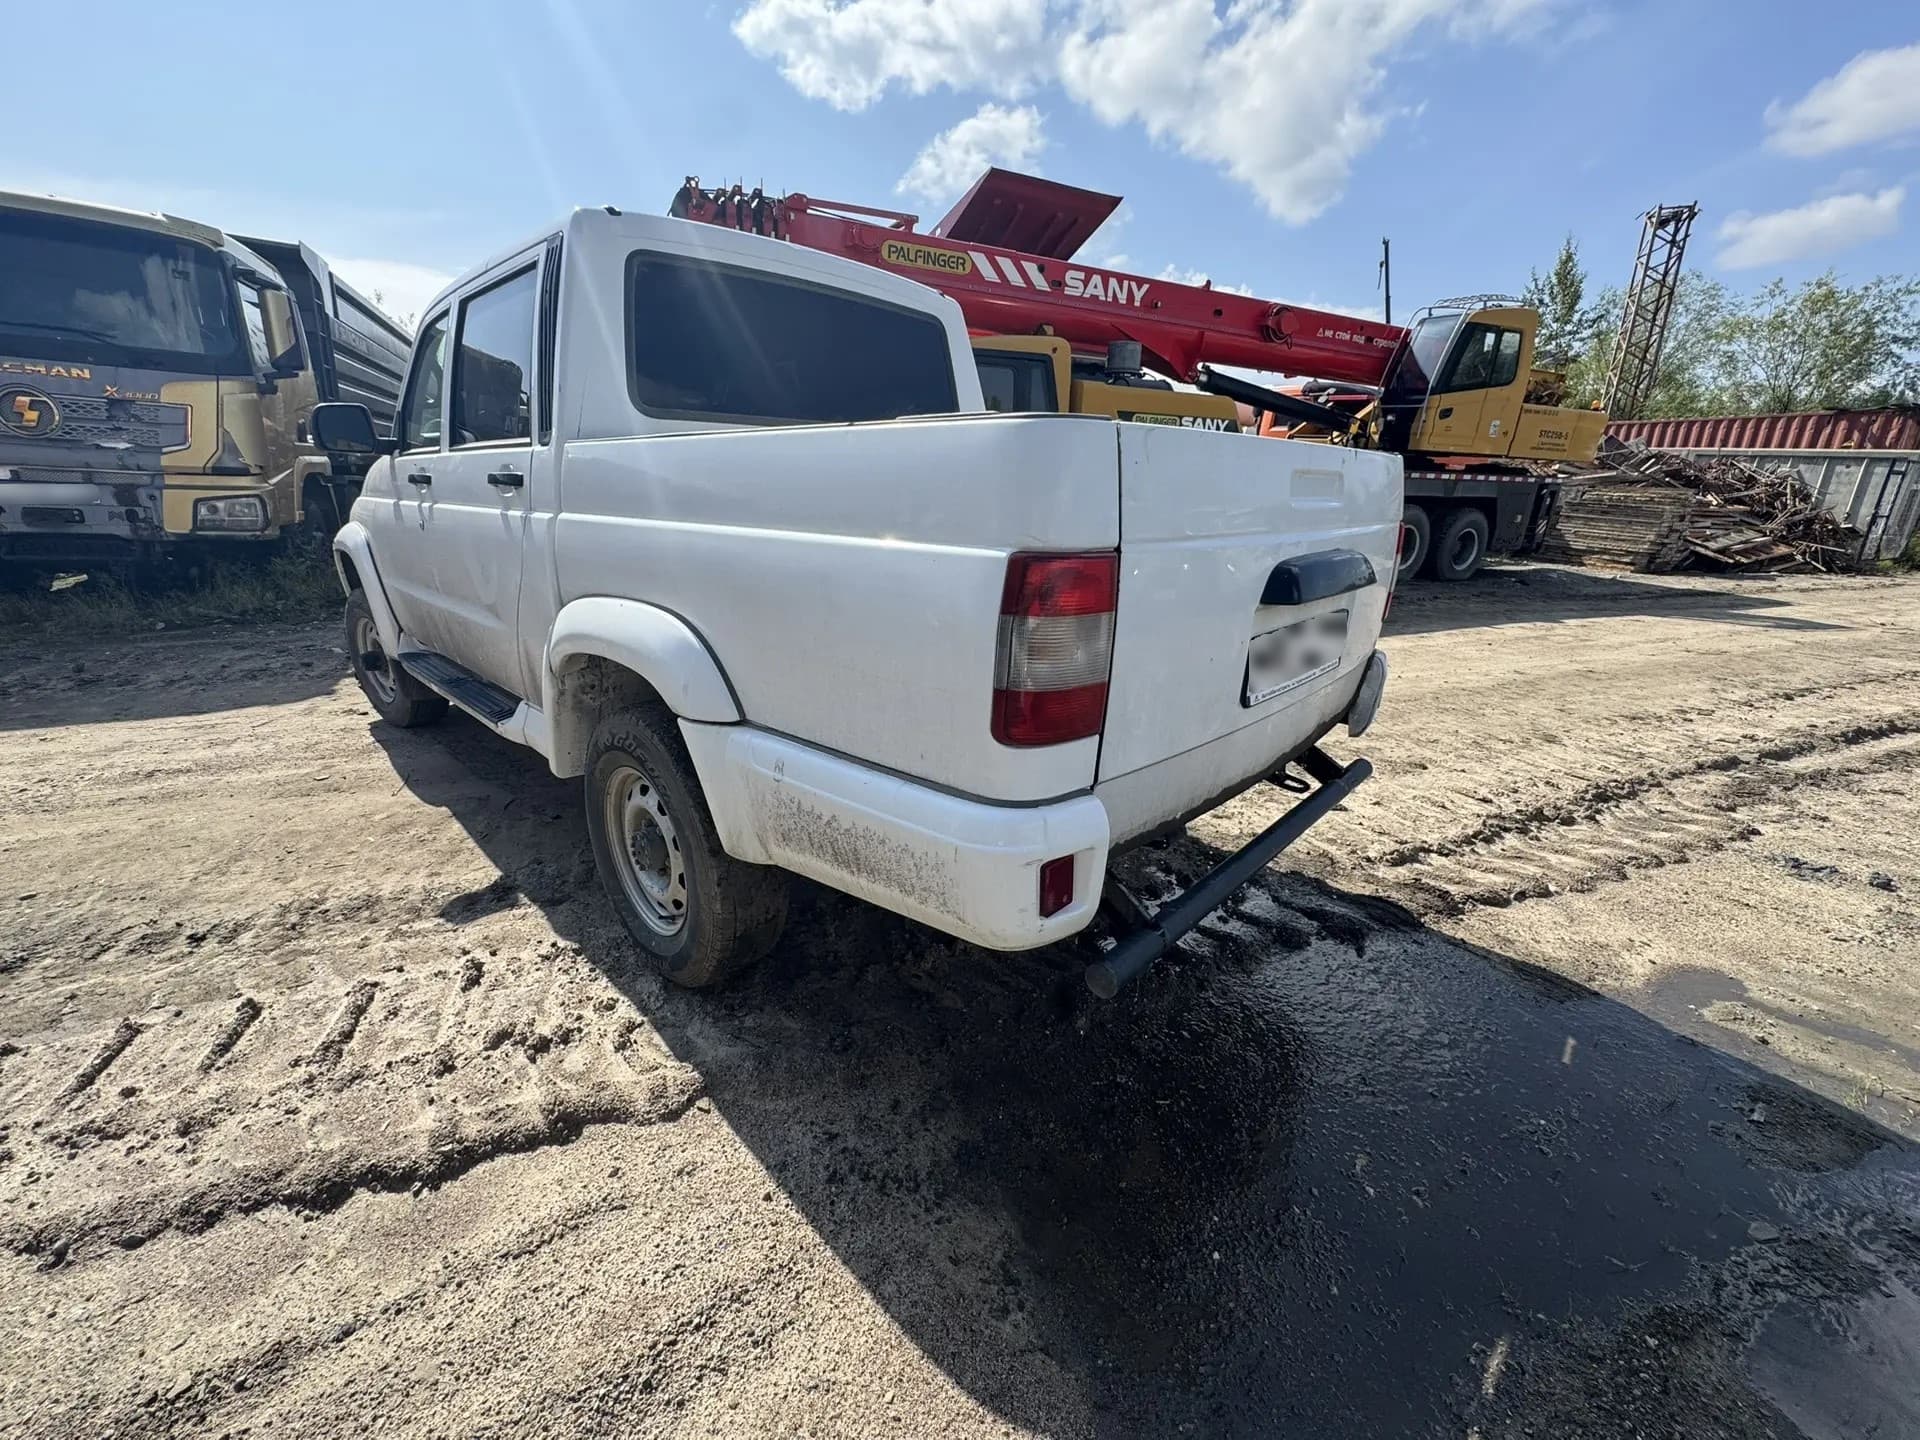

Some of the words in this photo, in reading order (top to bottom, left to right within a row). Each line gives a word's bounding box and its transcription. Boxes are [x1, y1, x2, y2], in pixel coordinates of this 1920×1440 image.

[887, 243, 967, 272] PALFINGER
[1063, 269, 1150, 307] SANY
[0, 361, 92, 380] CMAN
[1181, 416, 1230, 432] SANY
